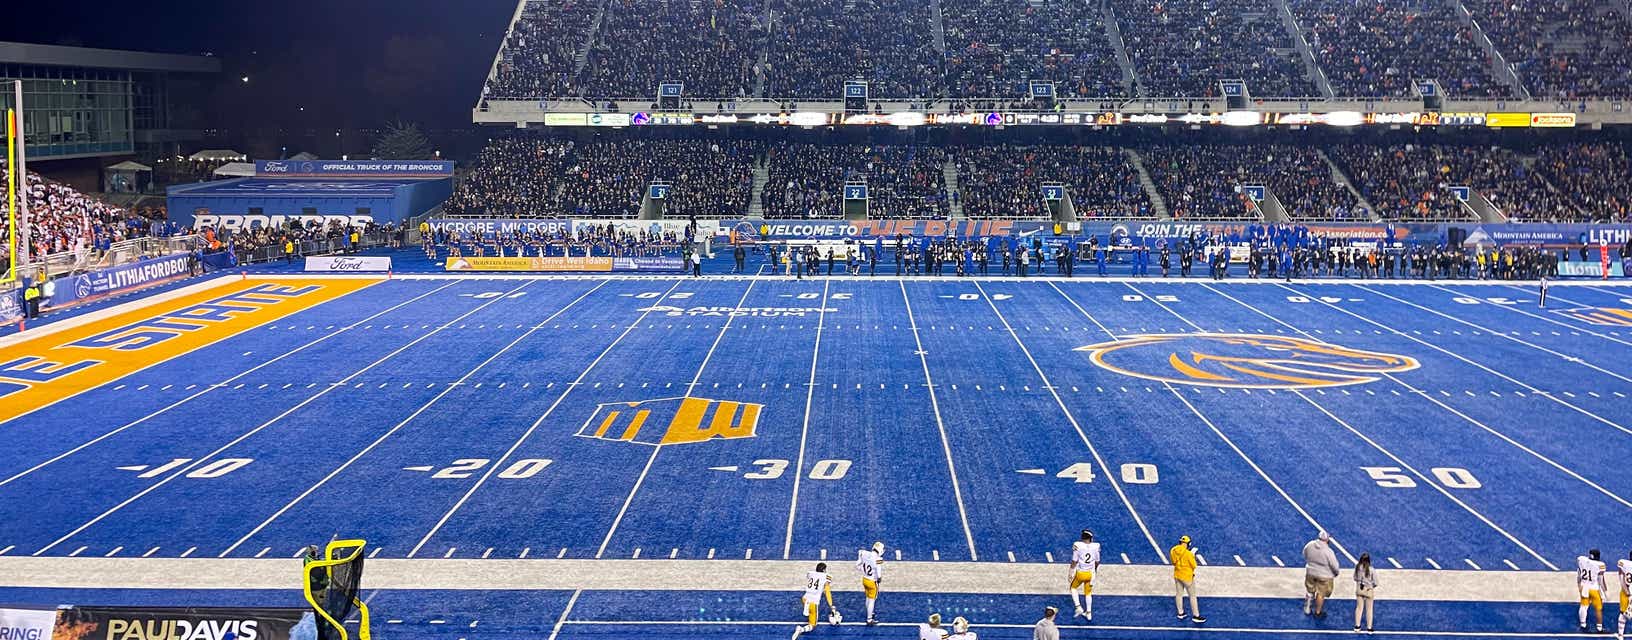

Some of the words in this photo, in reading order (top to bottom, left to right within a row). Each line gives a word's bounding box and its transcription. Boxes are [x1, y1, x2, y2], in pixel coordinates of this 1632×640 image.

[850, 87, 861, 95] 122
[1226, 86, 1236, 94] 124
[264, 161, 288, 172] Ford
[430, 222, 494, 234] MICROBE
[767, 224, 835, 236] WELCOME
[838, 224, 859, 236] TO
[1136, 224, 1169, 236] JOIN
[1173, 224, 1202, 236] THE
[1493, 232, 1531, 240] MOUNTAIN
[1531, 232, 1563, 240] AMERICA
[330, 257, 363, 270] Ford
[49, 283, 327, 352] STATE
[1085, 553, 1091, 564] 2
[863, 562, 873, 577] 12
[1581, 568, 1593, 582] 21
[807, 577, 820, 590] 34
